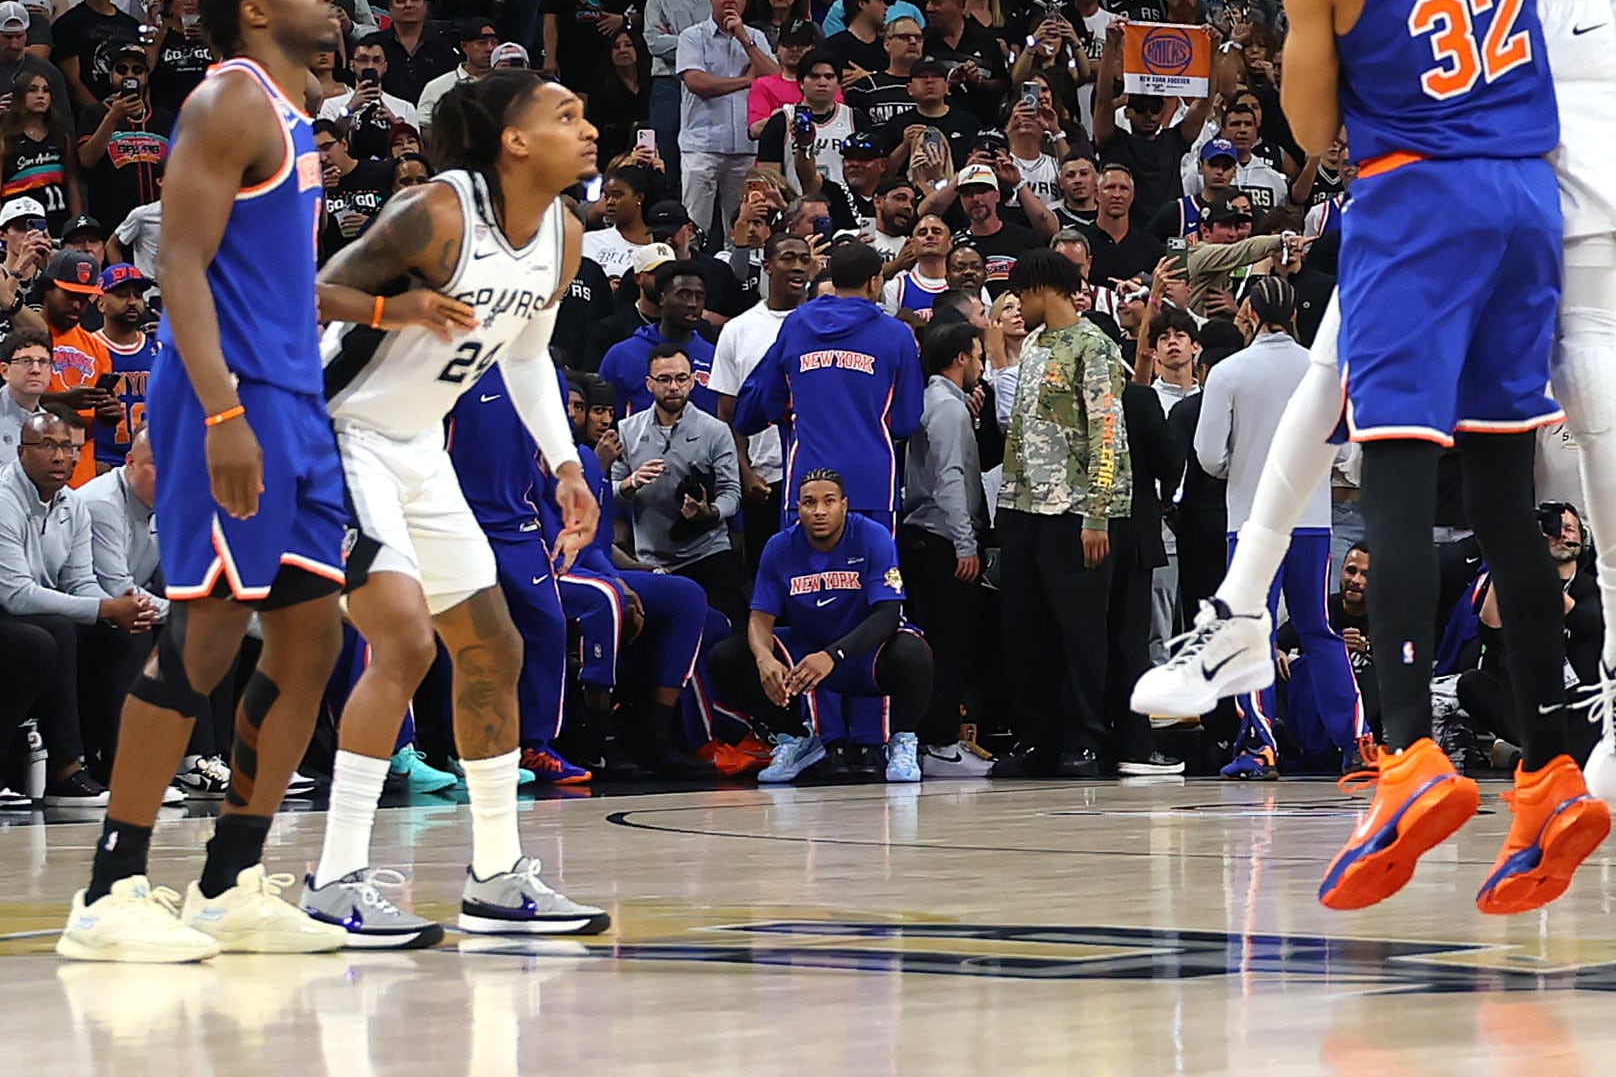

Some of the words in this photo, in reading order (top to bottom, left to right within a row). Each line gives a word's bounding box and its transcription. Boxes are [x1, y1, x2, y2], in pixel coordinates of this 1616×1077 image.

[799, 350, 834, 374] NEW
[834, 350, 876, 376] YORK
[790, 574, 821, 597] NEW
[820, 570, 863, 591] YORK
